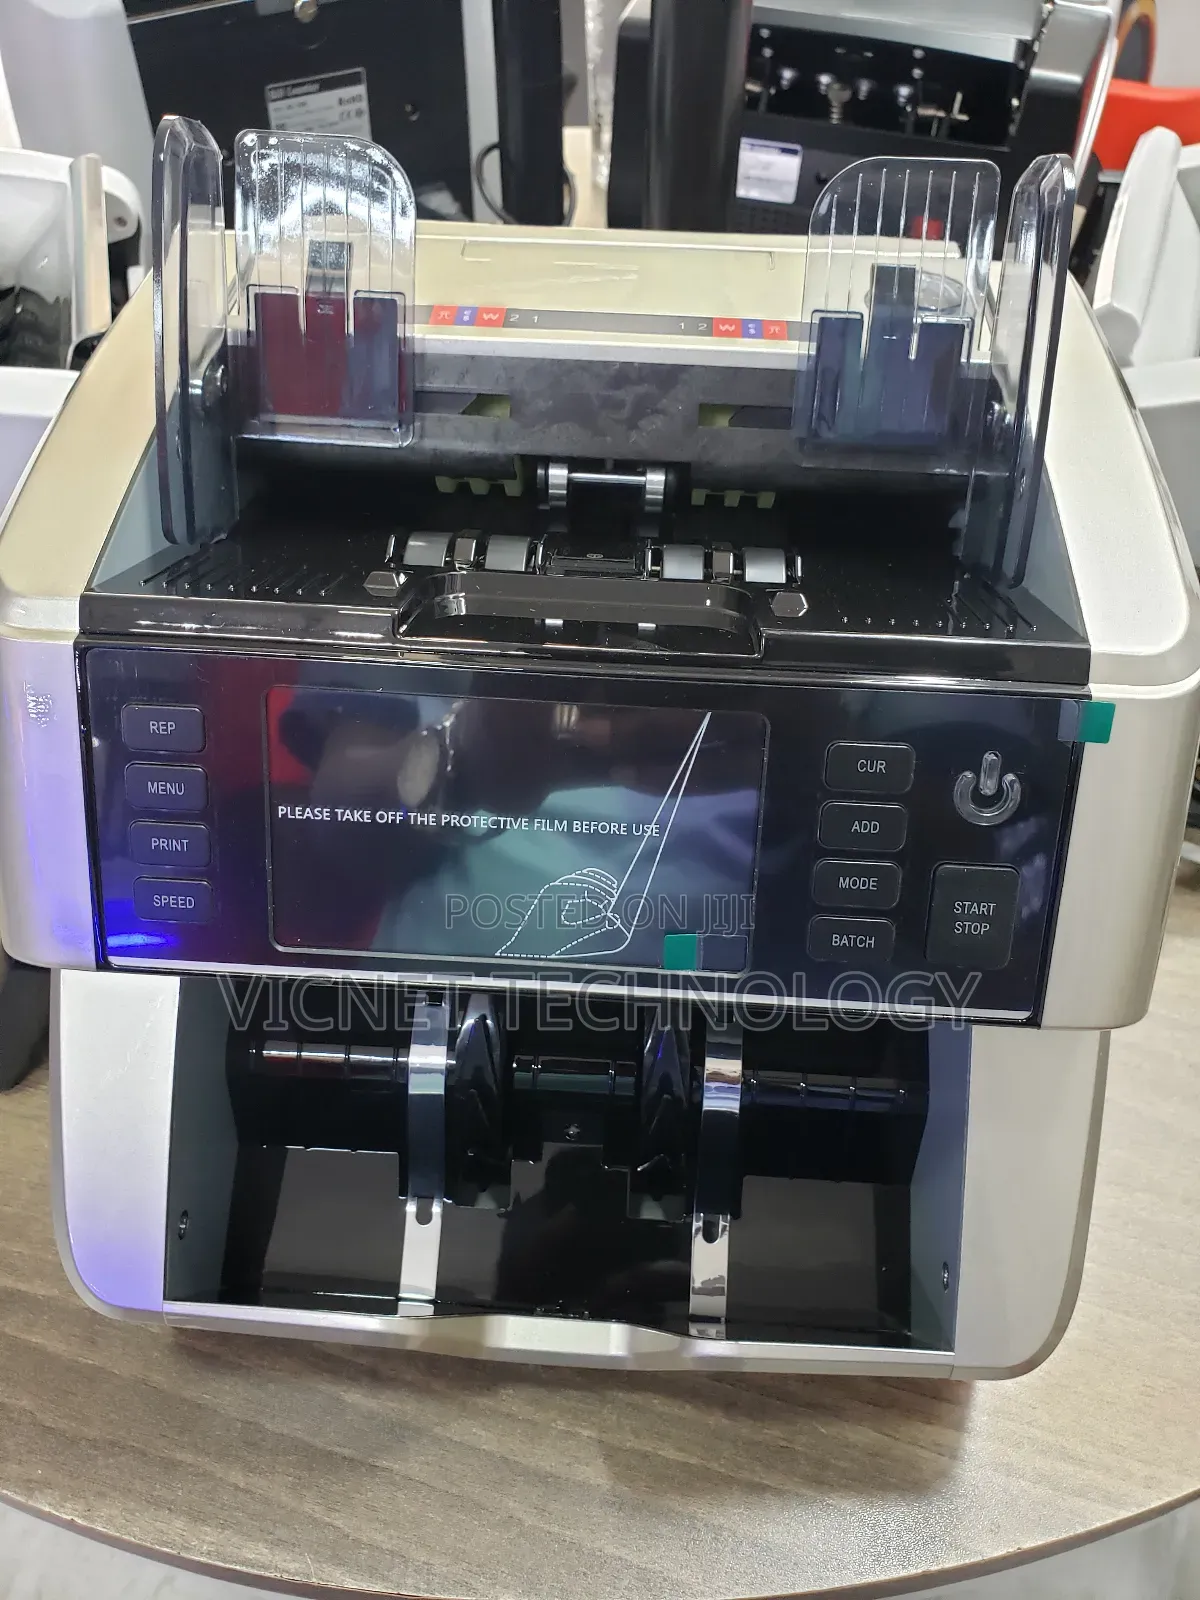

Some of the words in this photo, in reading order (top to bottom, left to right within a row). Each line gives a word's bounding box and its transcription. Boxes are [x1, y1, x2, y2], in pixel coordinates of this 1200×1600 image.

[509, 314, 520, 322] 2
[532, 315, 540, 323] 1
[679, 322, 685, 330] 1
[698, 323, 708, 331] 2
[149, 720, 176, 735] REP
[857, 759, 886, 774] CUR
[147, 781, 185, 796] MENU
[277, 805, 331, 821] PLEASE
[334, 808, 372, 823] TAKE
[375, 810, 404, 824] OFF
[407, 812, 437, 826] THE
[441, 814, 529, 831] PROTECTIVE
[533, 818, 567, 833] FILM
[572, 821, 628, 836] BEFORE
[632, 823, 660, 837] USE
[851, 820, 880, 834] ADD
[151, 837, 189, 852] PRINT
[838, 876, 879, 891] MODE
[153, 894, 195, 909] SPEED
[953, 901, 996, 916] START
[954, 921, 990, 936] STOP
[832, 933, 875, 948] BATCH
